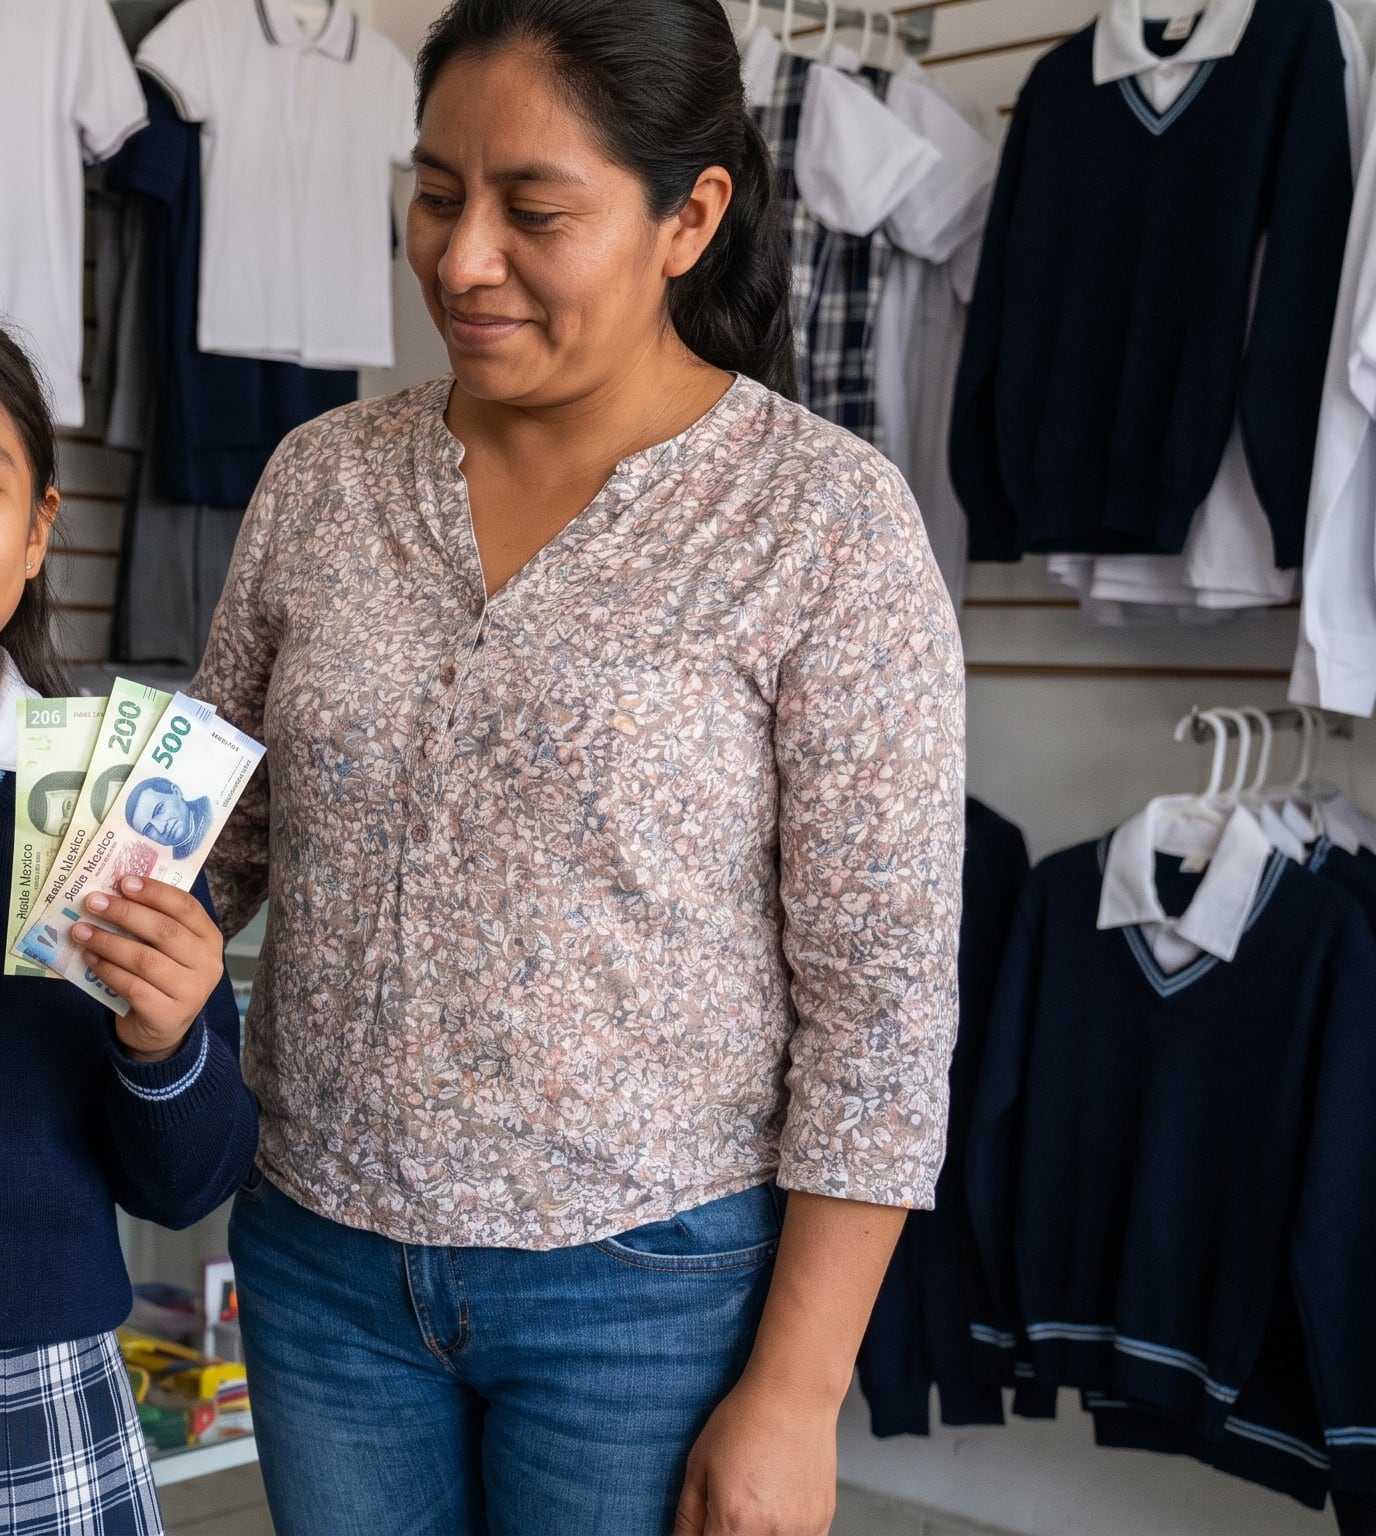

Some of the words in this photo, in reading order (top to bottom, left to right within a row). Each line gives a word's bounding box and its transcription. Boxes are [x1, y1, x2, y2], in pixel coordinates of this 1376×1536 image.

[31, 710, 61, 725] 206
[108, 700, 141, 755] 200
[151, 715, 192, 770] 500
[19, 844, 33, 886] Mexico
[60, 829, 86, 872] Mexico
